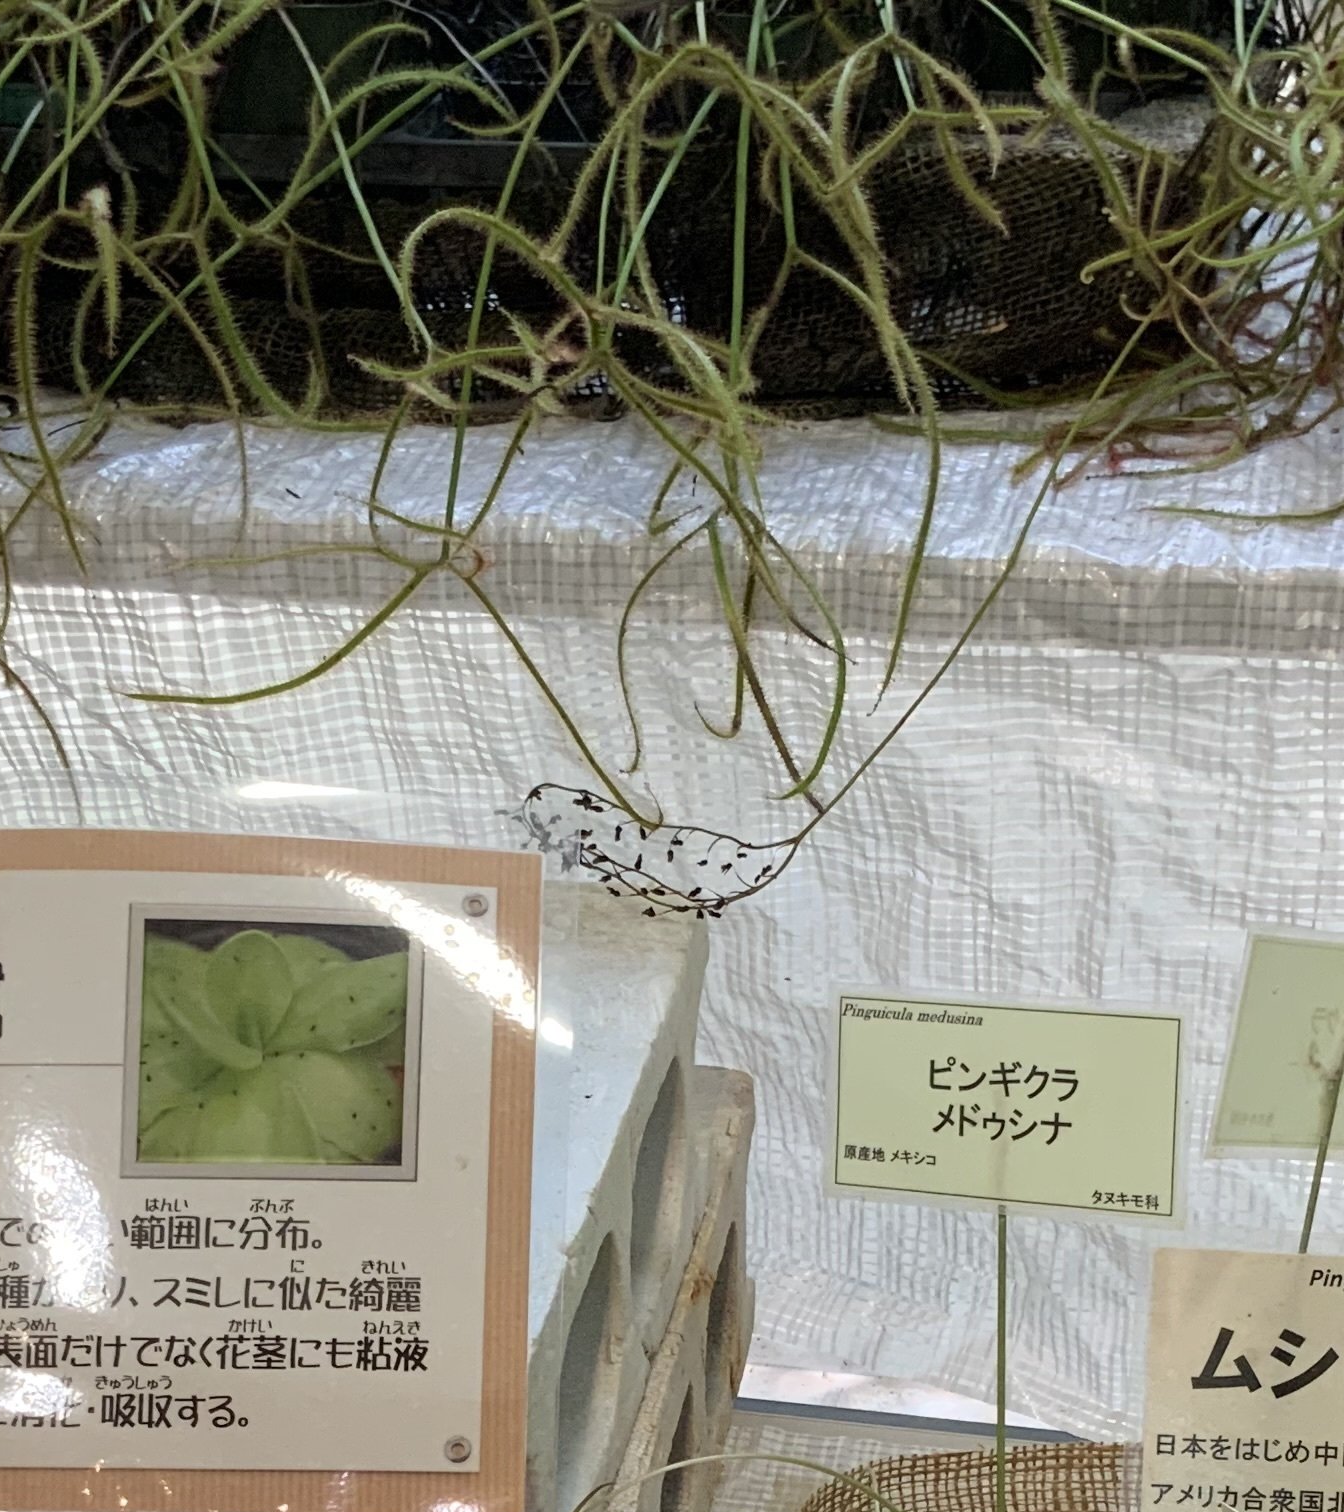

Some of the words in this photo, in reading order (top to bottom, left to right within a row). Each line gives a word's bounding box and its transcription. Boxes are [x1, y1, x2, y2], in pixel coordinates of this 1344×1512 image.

[842, 1003, 913, 1021] Pinguicula
[916, 1011, 984, 1027] medusina
[928, 1056, 1080, 1102] ピンギクラ
[932, 1103, 1073, 1146] メドゥシナ
[844, 1144, 885, 1163] 原産地
[890, 1149, 937, 1166] メキシコ
[145, 1198, 188, 1212] はんい
[1092, 1190, 1160, 1211] タヌキモ科
[361, 1260, 406, 1274] きれい
[228, 1319, 273, 1334] かけい
[94, 1375, 172, 1391] きゅうしゅう
